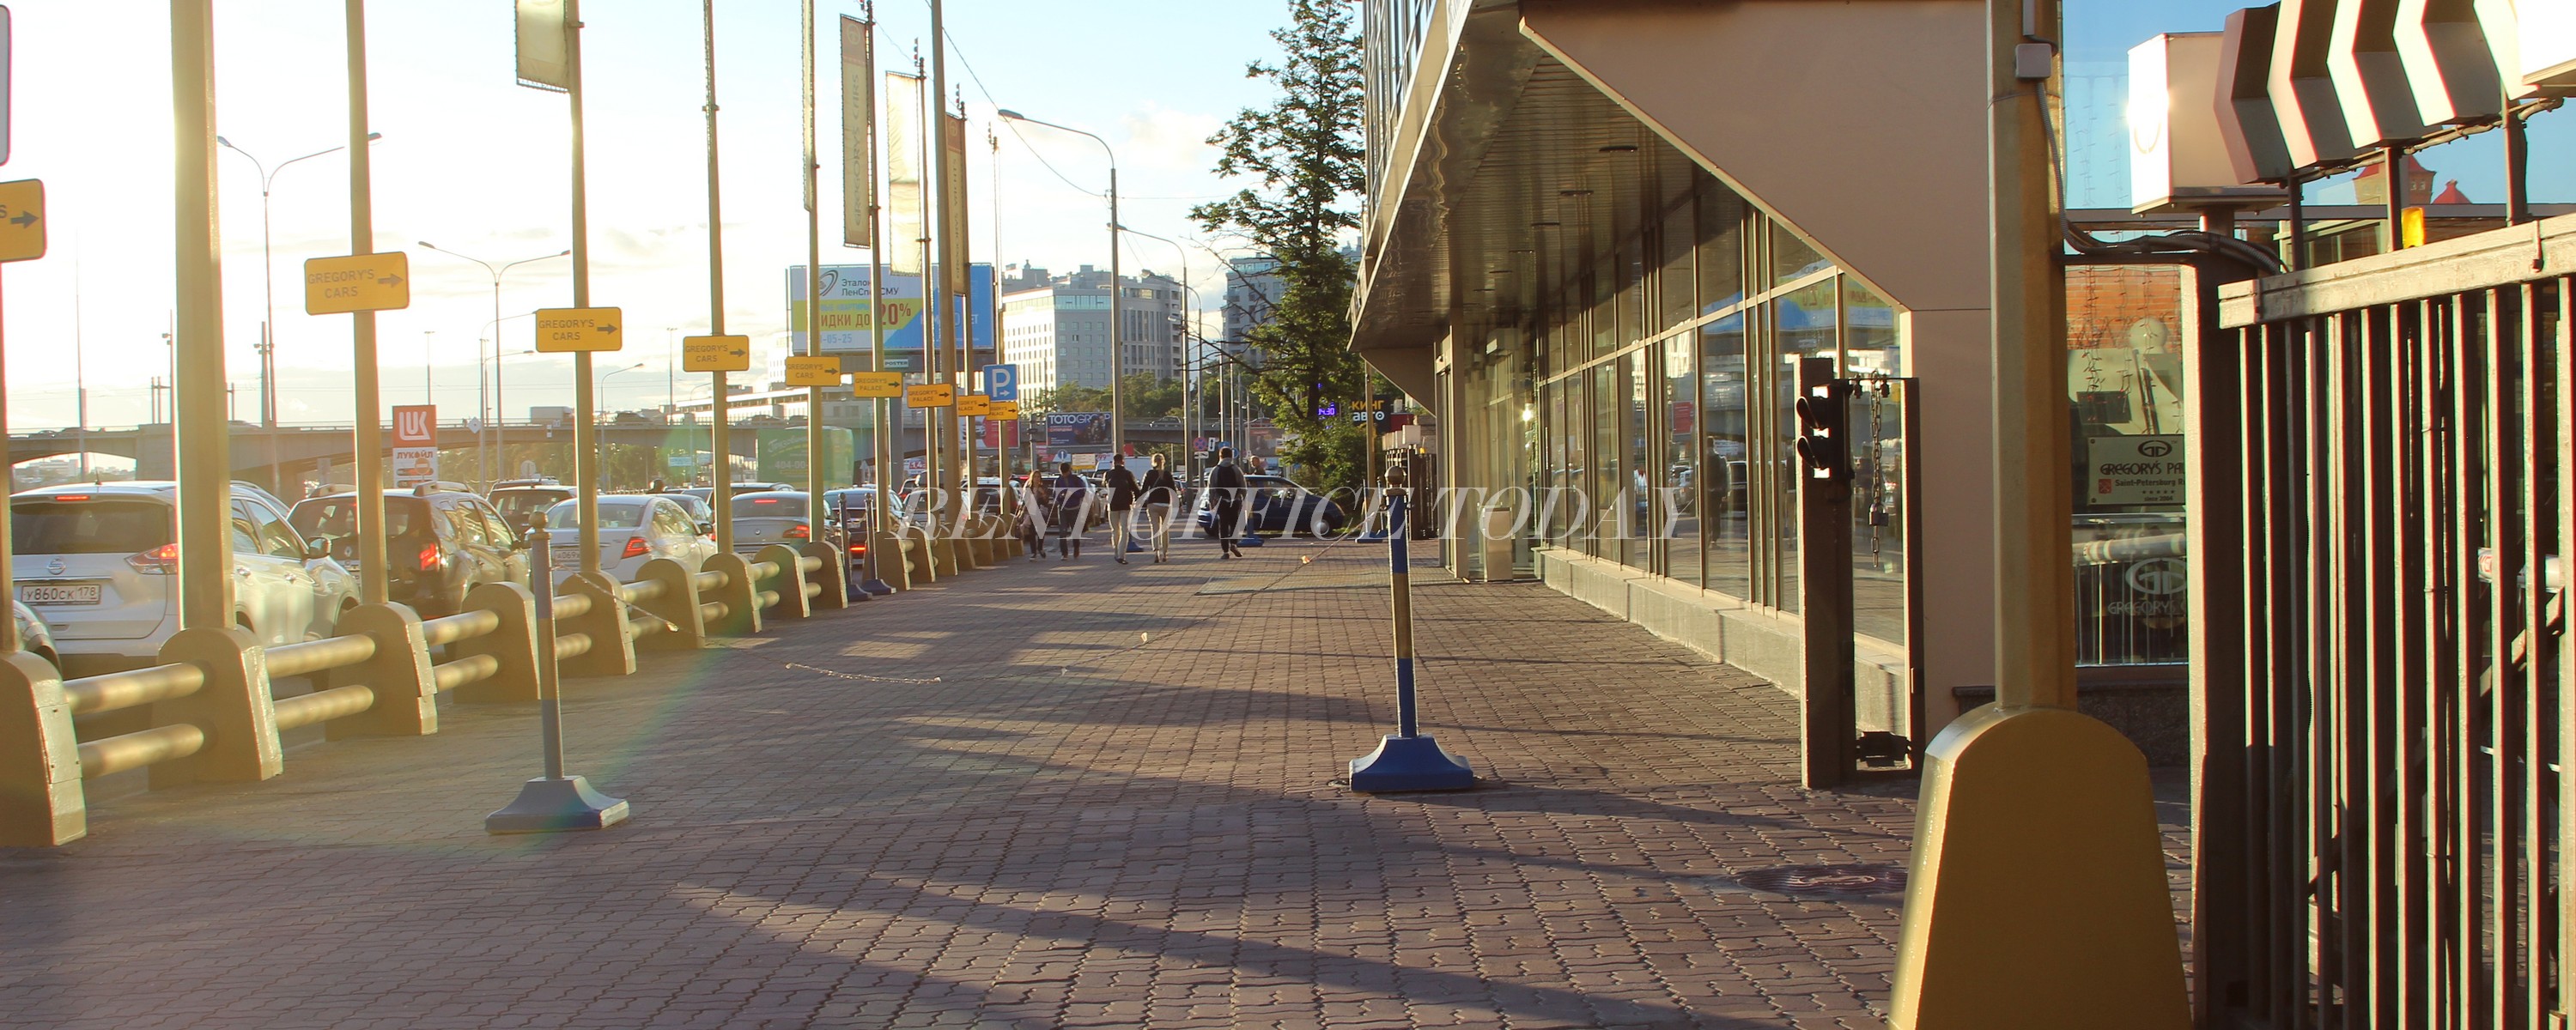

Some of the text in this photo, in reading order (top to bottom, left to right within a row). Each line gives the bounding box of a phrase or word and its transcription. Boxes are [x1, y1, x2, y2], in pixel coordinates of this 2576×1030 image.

[308, 269, 375, 284] GREGORY'S
[325, 286, 358, 299] CARS
[538, 319, 594, 329] GREGORY'S
[552, 331, 580, 341] CARS
[992, 368, 1011, 397] P
[397, 451, 433, 459] ЛУКОЙЛ
[2099, 461, 2162, 476] GREGORY'S
[78, 586, 97, 597] 178
